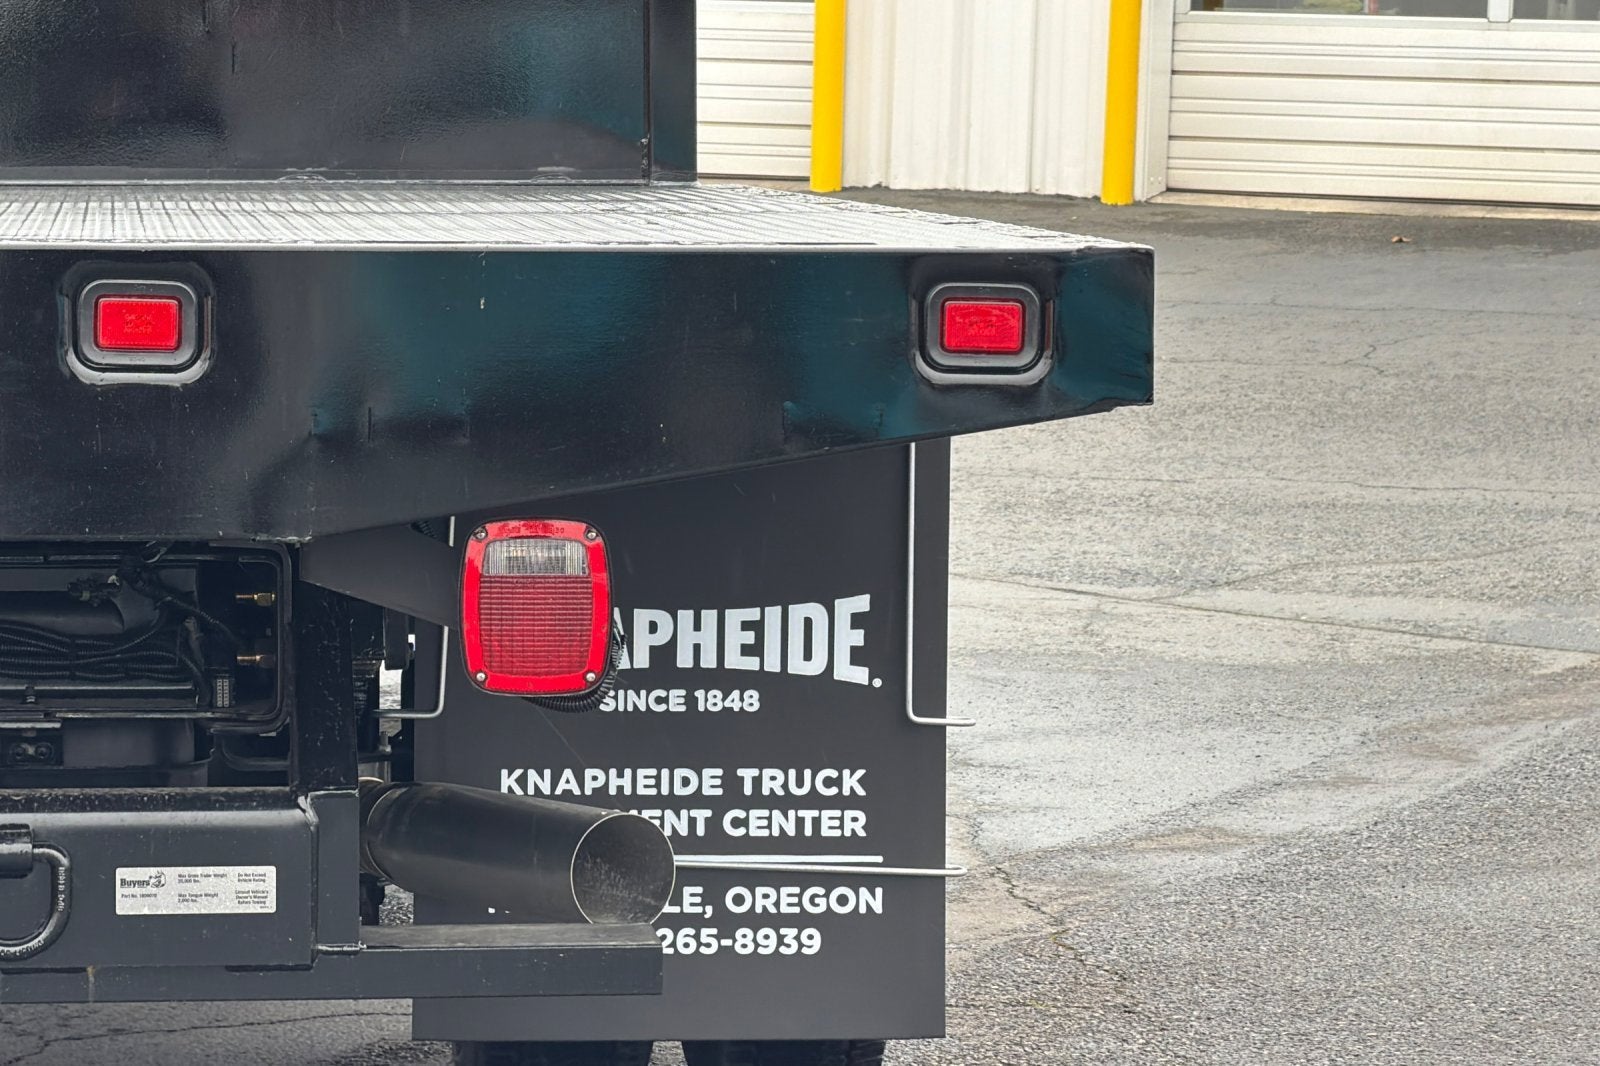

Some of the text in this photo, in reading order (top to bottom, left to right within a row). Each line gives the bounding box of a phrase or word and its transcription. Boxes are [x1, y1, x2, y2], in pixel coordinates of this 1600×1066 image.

[599, 689, 761, 712] SINCE 1848
[500, 768, 867, 796] KNAPHEIDE TRUCK
[723, 809, 867, 837] CENTER
[120, 878, 150, 888] Buyers
[724, 886, 883, 914] OREGON
